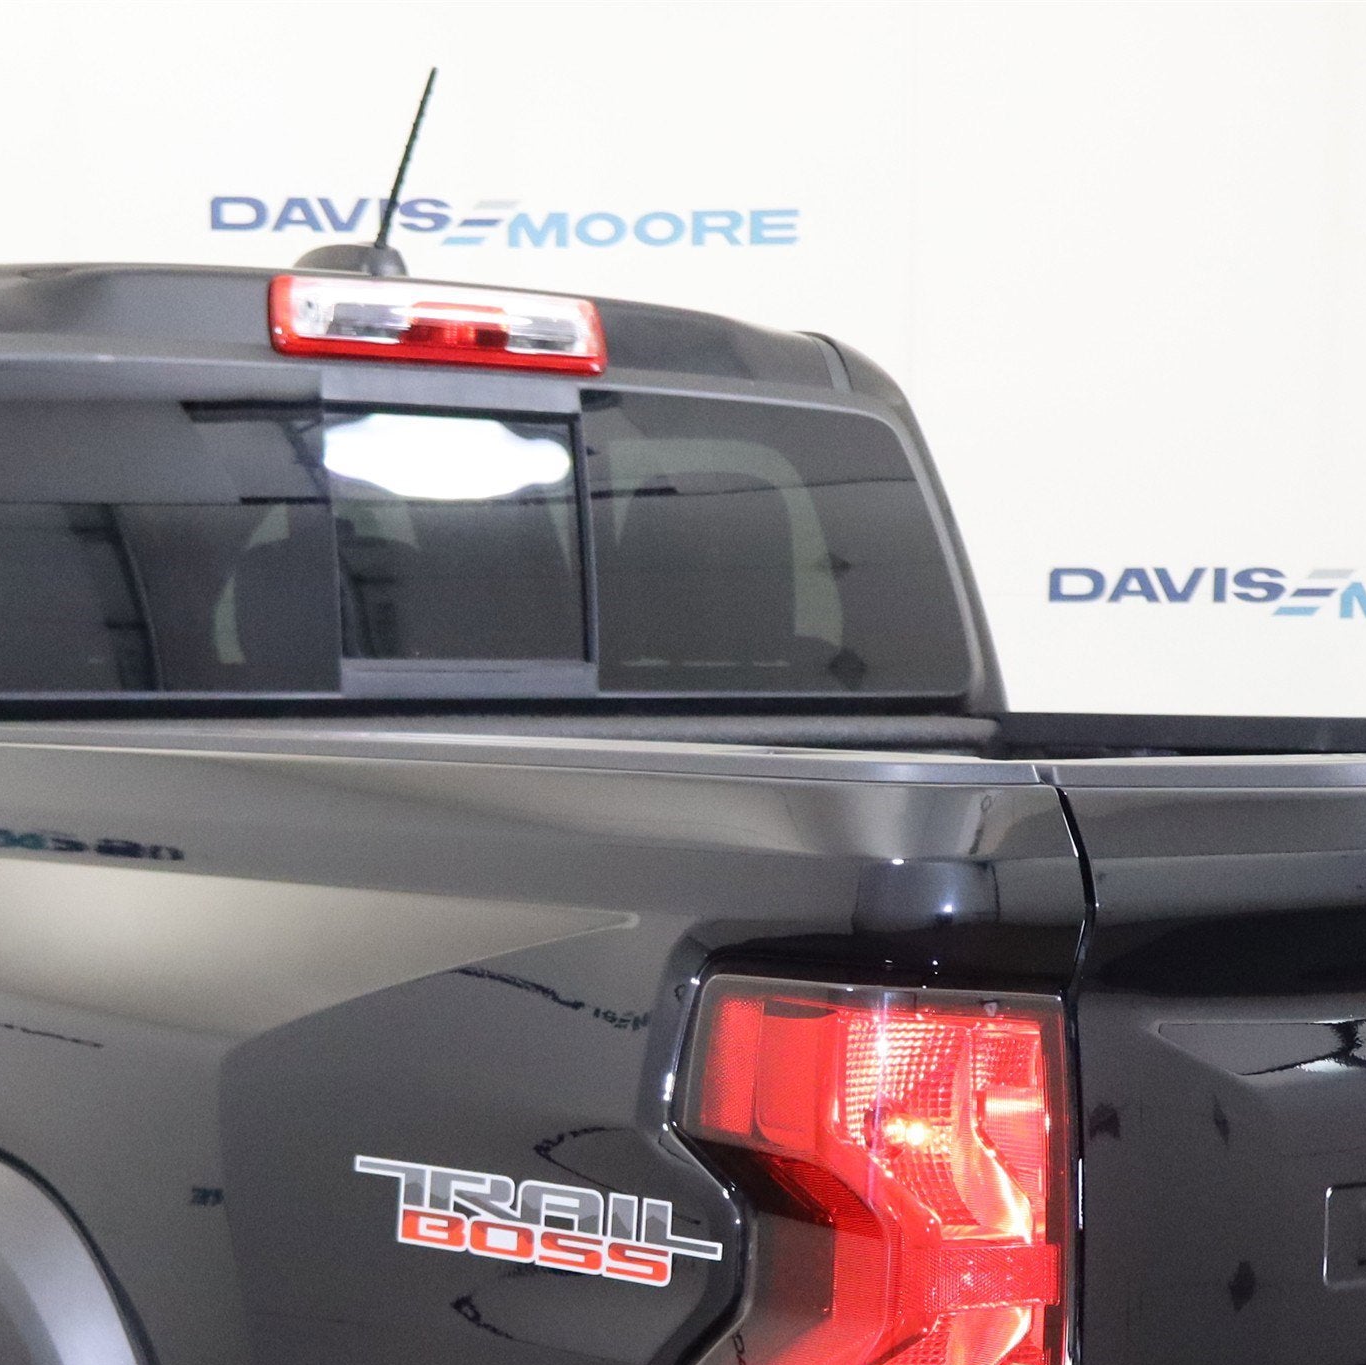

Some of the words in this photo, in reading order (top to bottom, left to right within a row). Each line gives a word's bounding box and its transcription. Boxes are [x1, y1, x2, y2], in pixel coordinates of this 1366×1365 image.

[508, 208, 800, 248] MOORE
[1048, 566, 1287, 604] DAVIS
[353, 1154, 724, 1261] TRAIL
[397, 1206, 673, 1288] BOSS
